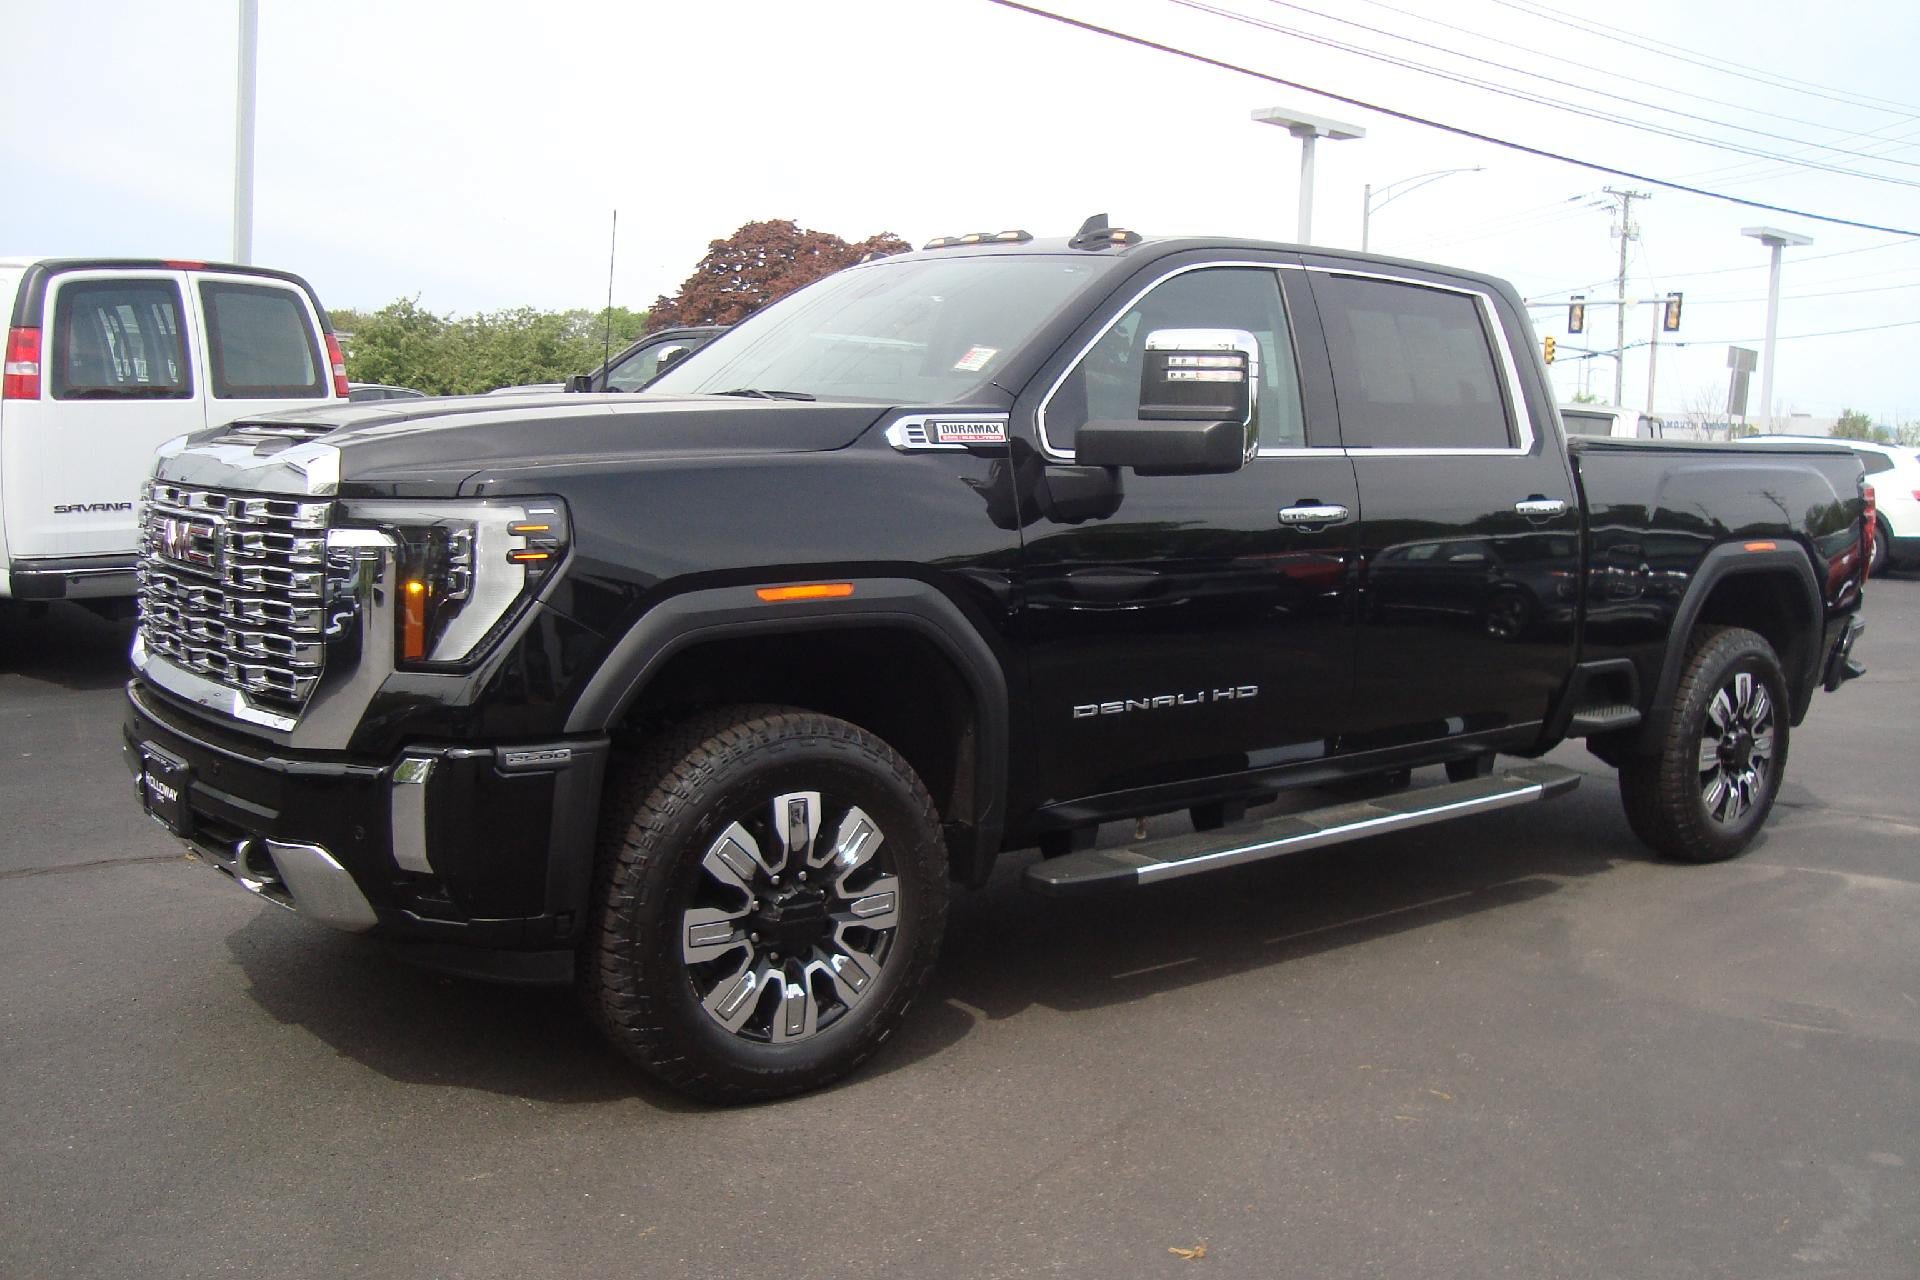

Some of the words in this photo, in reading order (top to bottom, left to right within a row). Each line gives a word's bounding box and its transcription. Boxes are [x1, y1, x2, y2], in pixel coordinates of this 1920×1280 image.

[941, 424, 1000, 434] DURAMAX
[53, 502, 132, 514] SAVANA
[151, 515, 214, 567] GMC
[1073, 691, 1205, 719] DENALI
[1212, 685, 1259, 702] HD
[145, 770, 179, 802] HOLLOWAY
